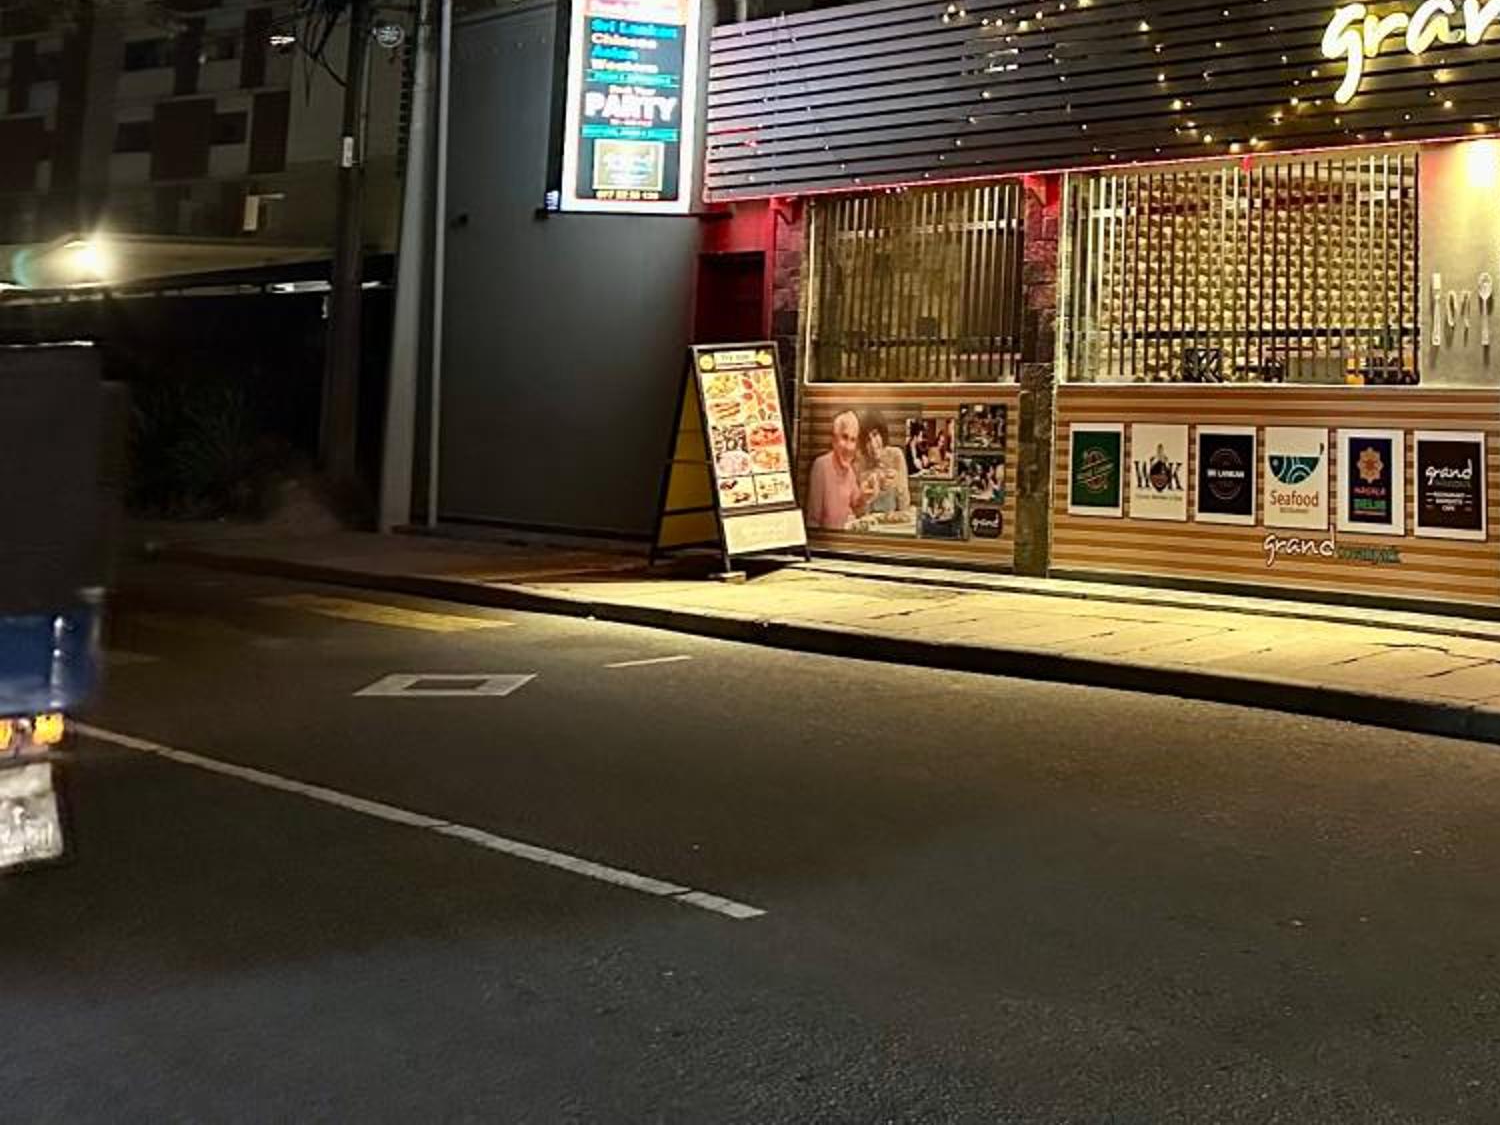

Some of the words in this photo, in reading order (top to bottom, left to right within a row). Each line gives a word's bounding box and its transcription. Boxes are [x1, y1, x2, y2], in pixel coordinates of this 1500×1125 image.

[585, 92, 678, 122] PARTY
[1425, 458, 1473, 486] grand
[1270, 490, 1320, 508] Seafood
[1264, 524, 1335, 567] grand
